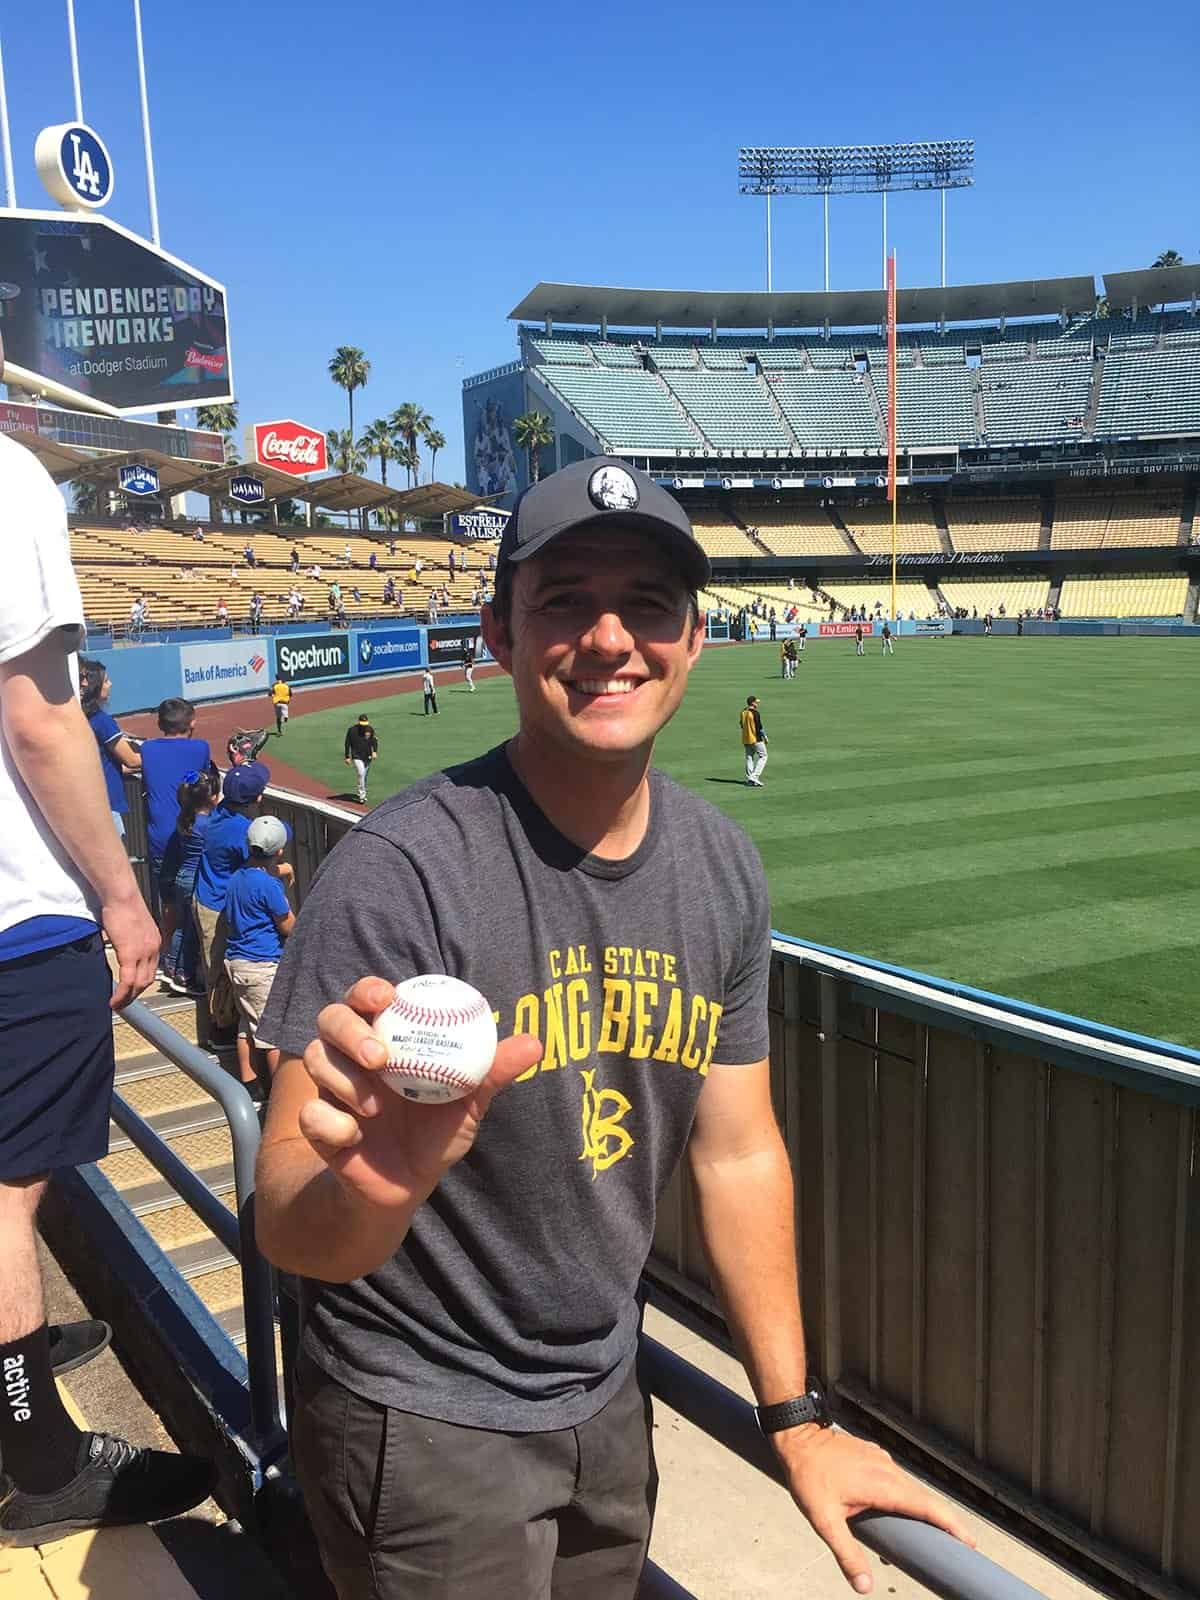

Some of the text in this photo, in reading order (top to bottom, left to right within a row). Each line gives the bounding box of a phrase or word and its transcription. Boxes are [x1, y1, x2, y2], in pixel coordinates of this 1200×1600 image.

[71, 134, 101, 196] LA
[174, 287, 215, 311] DAY
[69, 356, 168, 376] at Dodger Stadium
[0, 421, 35, 432] mirates
[262, 431, 322, 464] Coca-Cola
[863, 446, 909, 457] CLB
[232, 481, 262, 497] DASANI
[184, 663, 247, 684] Bank of America
[281, 644, 341, 676] Spectrum
[550, 945, 677, 982] CAL STATE
[492, 978, 591, 1083] ONG
[3, 1354, 32, 1422] active
